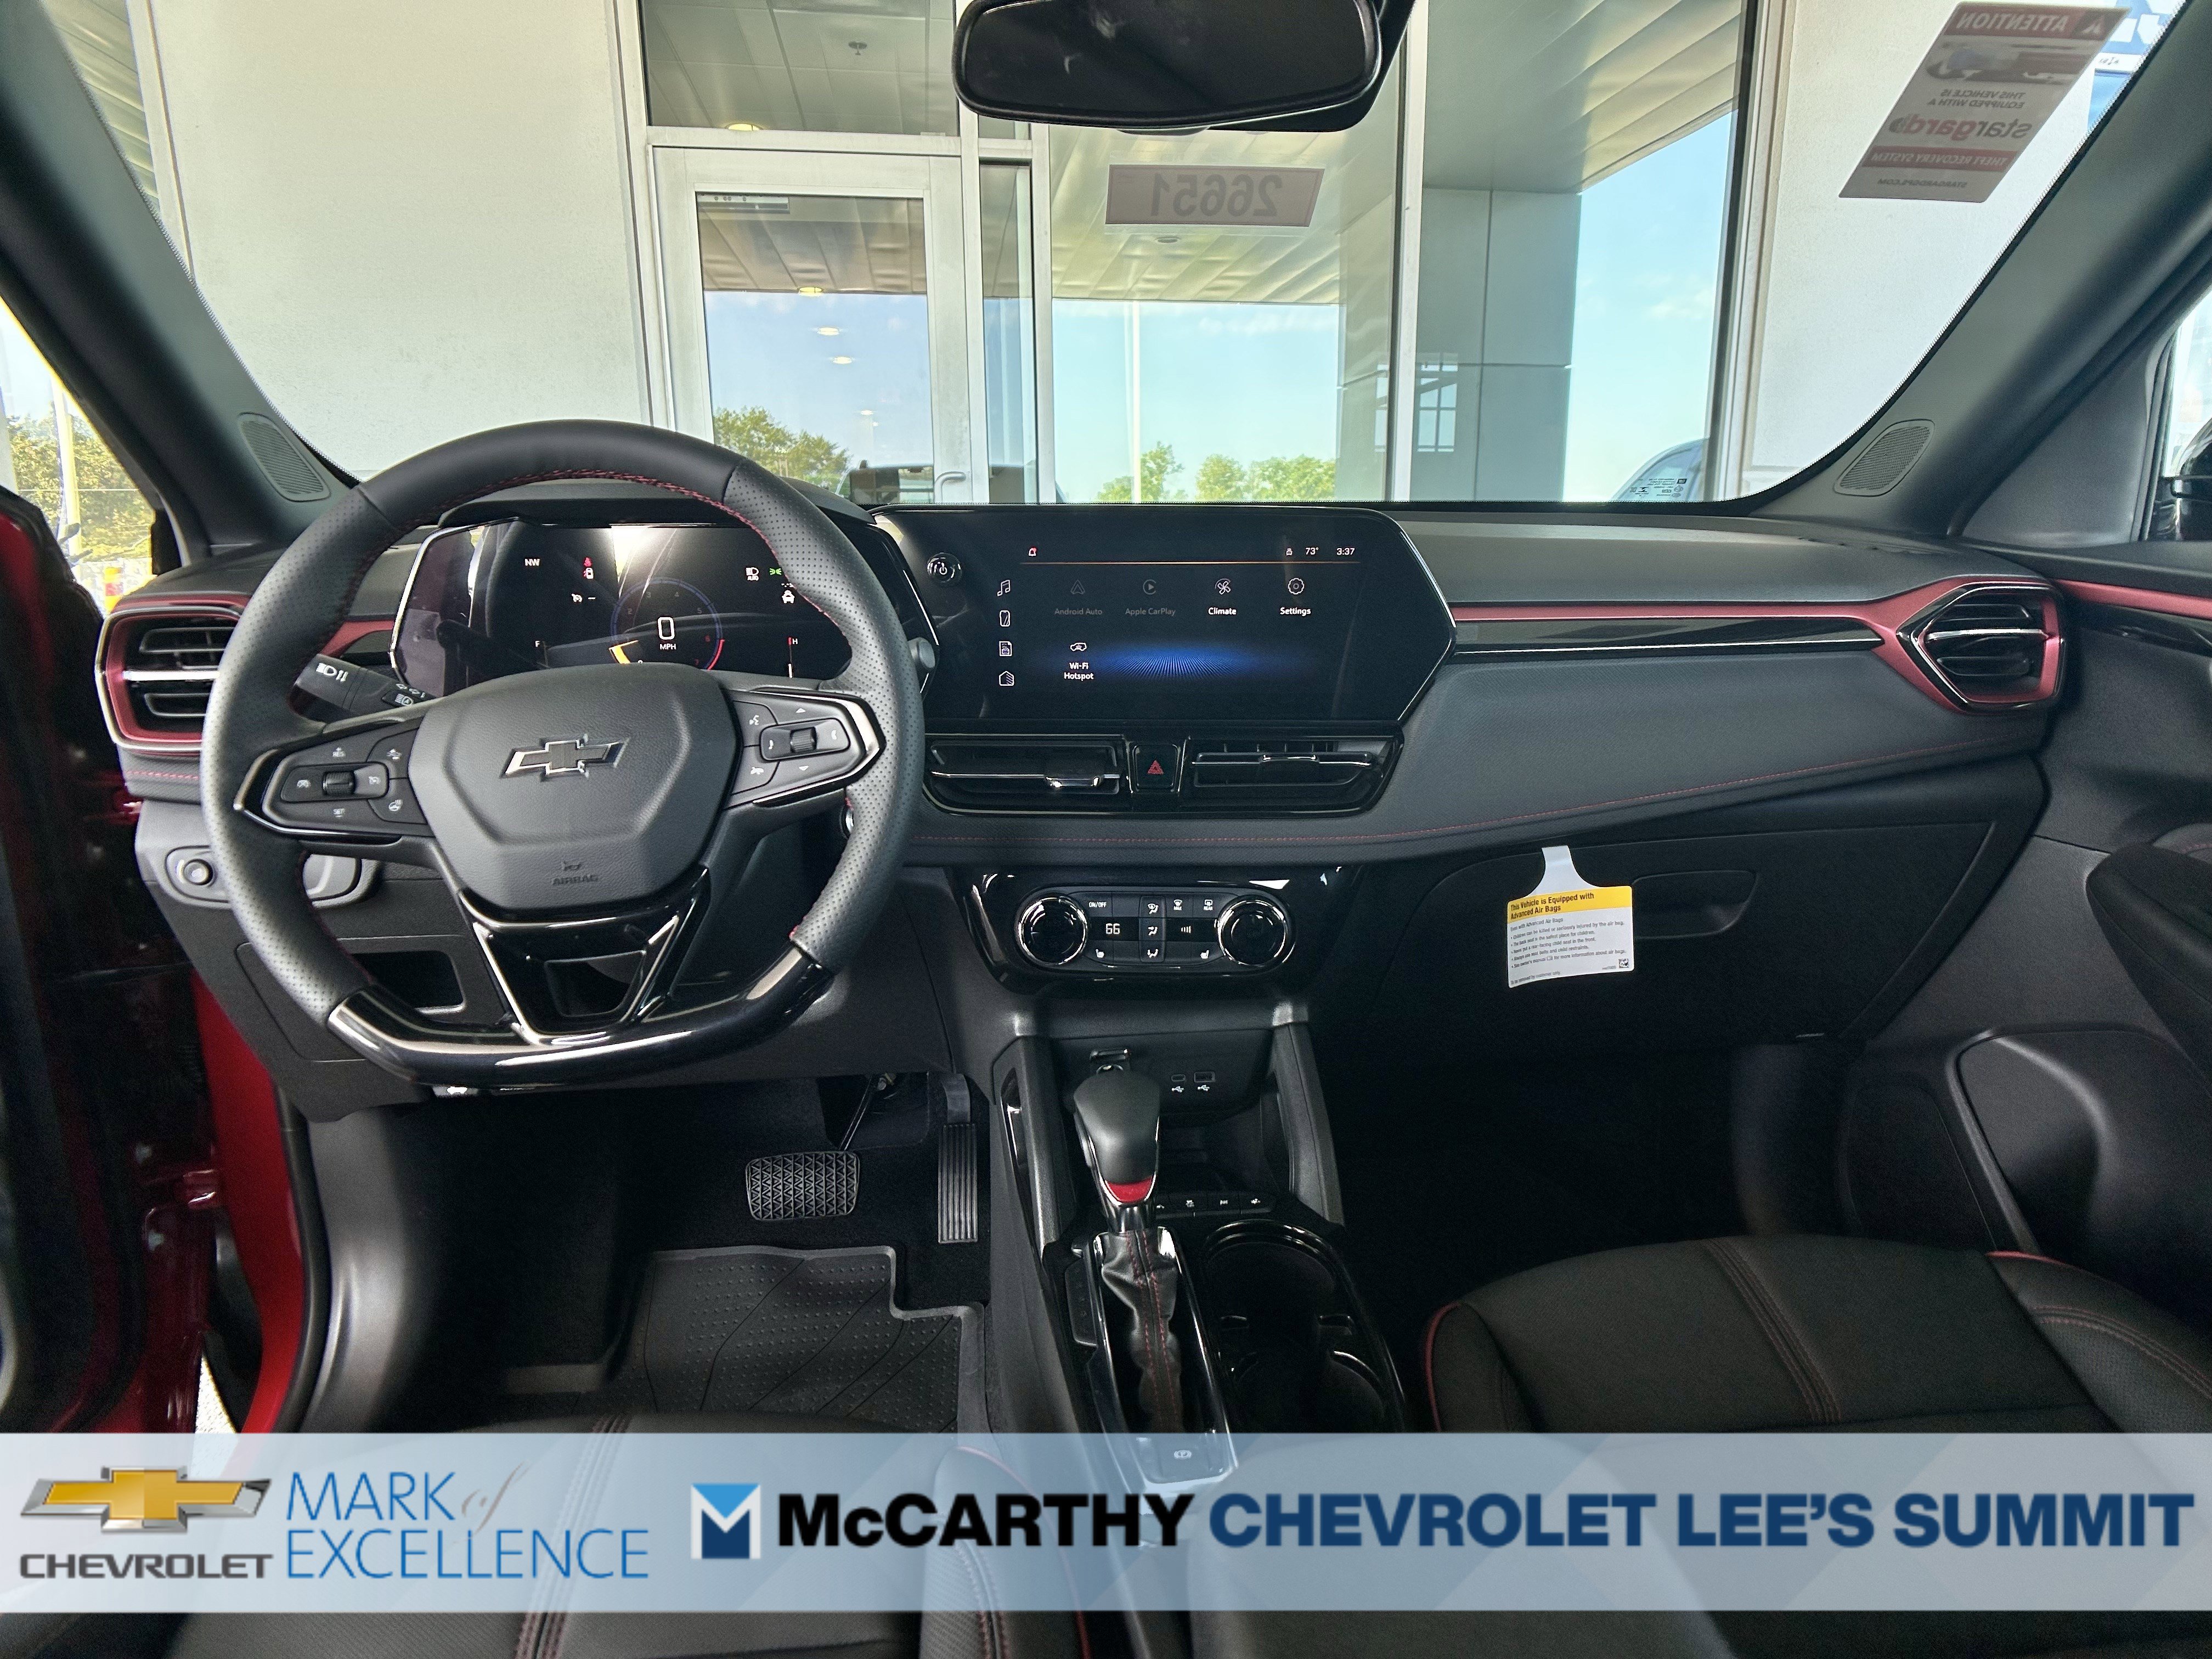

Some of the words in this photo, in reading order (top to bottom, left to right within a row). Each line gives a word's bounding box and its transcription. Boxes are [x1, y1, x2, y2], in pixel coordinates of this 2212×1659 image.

[1125, 608, 1147, 616] Apple
[1148, 608, 1176, 616] CarPlay
[1280, 607, 1311, 616] Settings
[1064, 672, 1094, 681] Hotspot
[1521, 899, 1539, 909] Vehicle
[1548, 894, 1578, 904] Equipped
[1511, 908, 1533, 919] Advanced
[1105, 923, 1120, 934] 66
